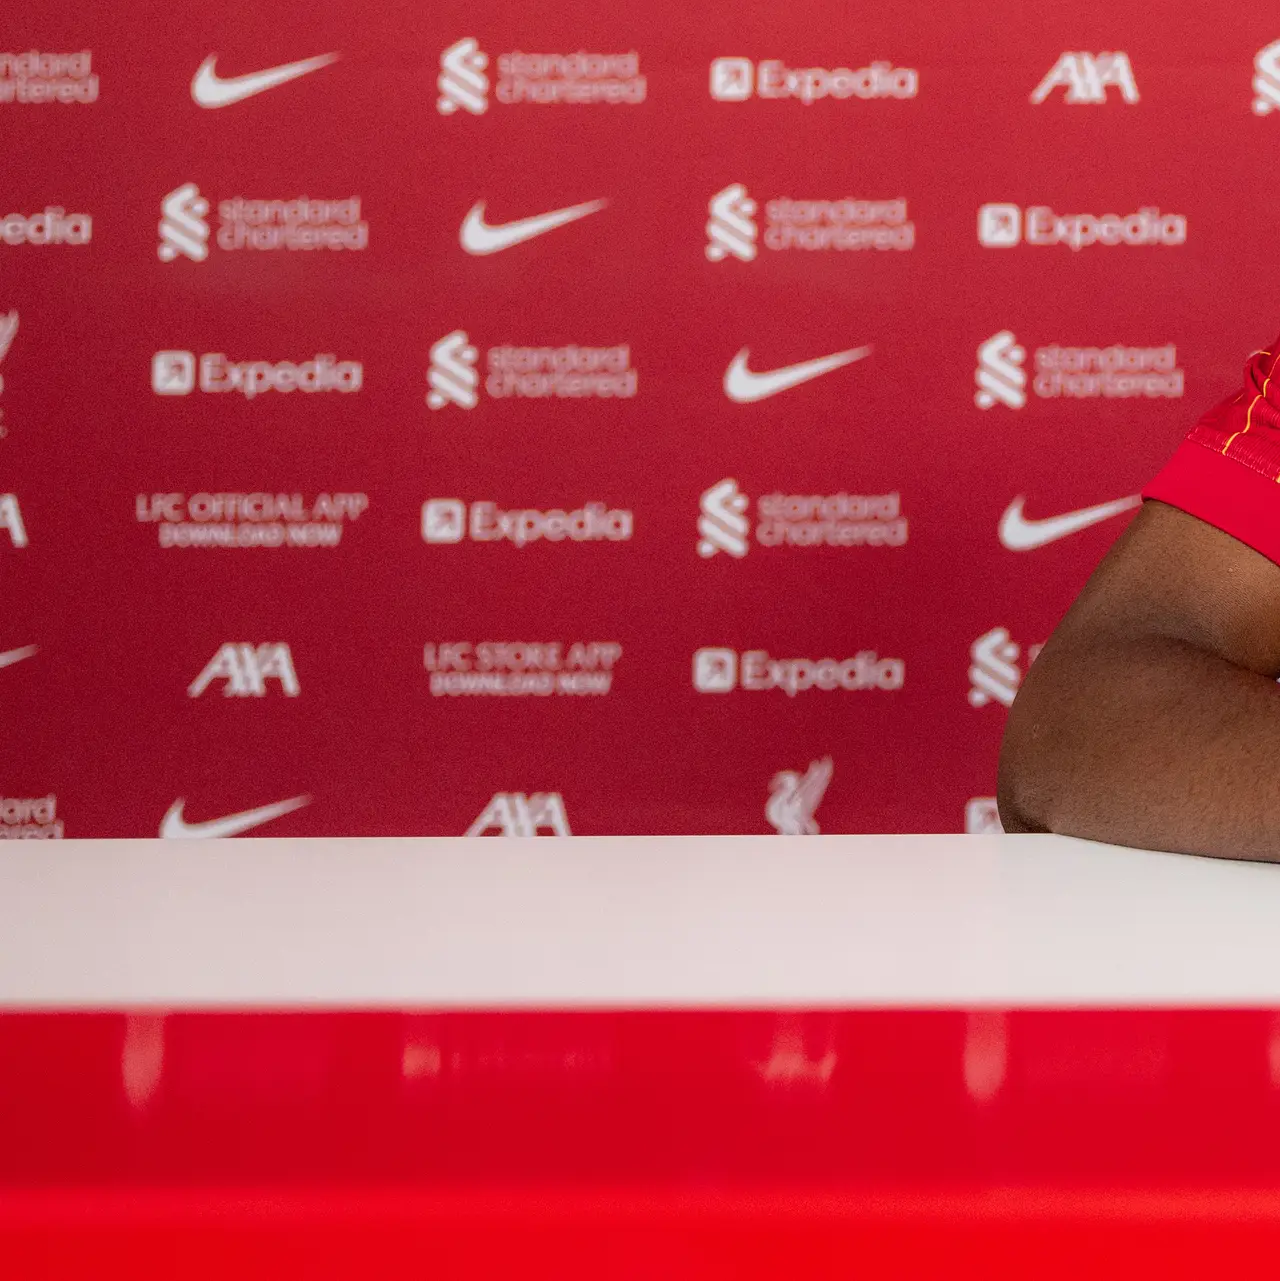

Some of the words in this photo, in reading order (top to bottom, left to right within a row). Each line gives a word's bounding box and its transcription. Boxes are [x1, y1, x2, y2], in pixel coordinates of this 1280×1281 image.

[754, 60, 918, 102] Expedia
[1033, 52, 1139, 103] AXA
[1022, 206, 1187, 249] Expedia
[196, 353, 363, 397] Expedia
[466, 501, 633, 546] Expedia
[190, 643, 299, 696] AXA
[737, 651, 904, 695] Expedia
